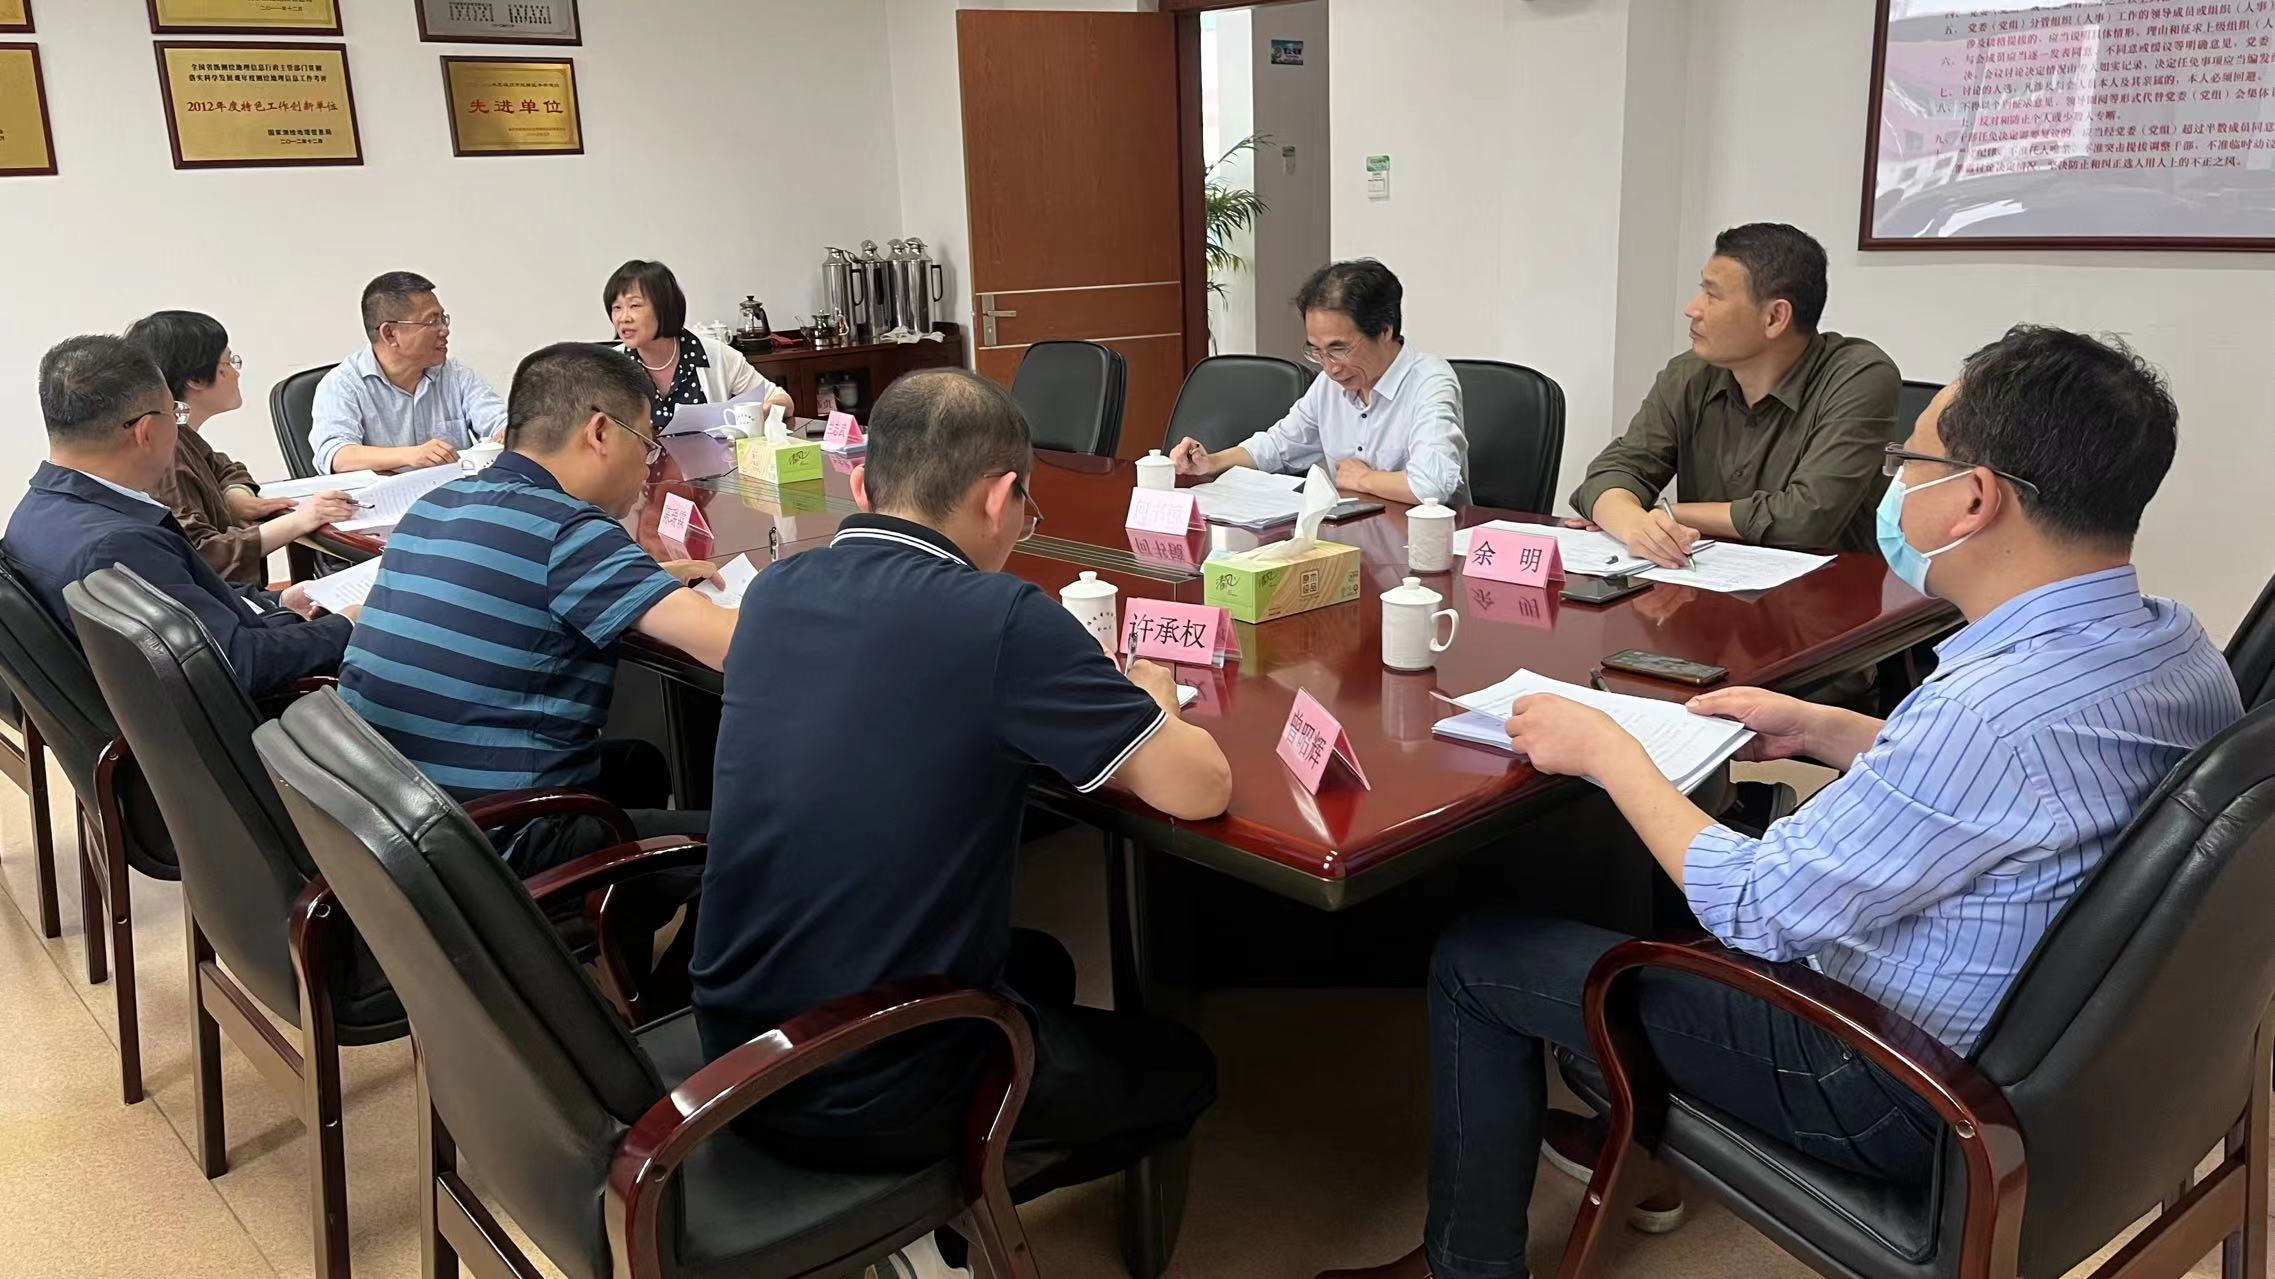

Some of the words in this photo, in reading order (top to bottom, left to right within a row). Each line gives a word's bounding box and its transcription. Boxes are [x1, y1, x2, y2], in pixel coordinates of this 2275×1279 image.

[187, 101, 339, 113] 2012年度特色工作创新单位
[468, 98, 564, 114] 先进单位
[1130, 613, 1207, 649] 许承权
[1287, 709, 1327, 769] 曾昭辉
